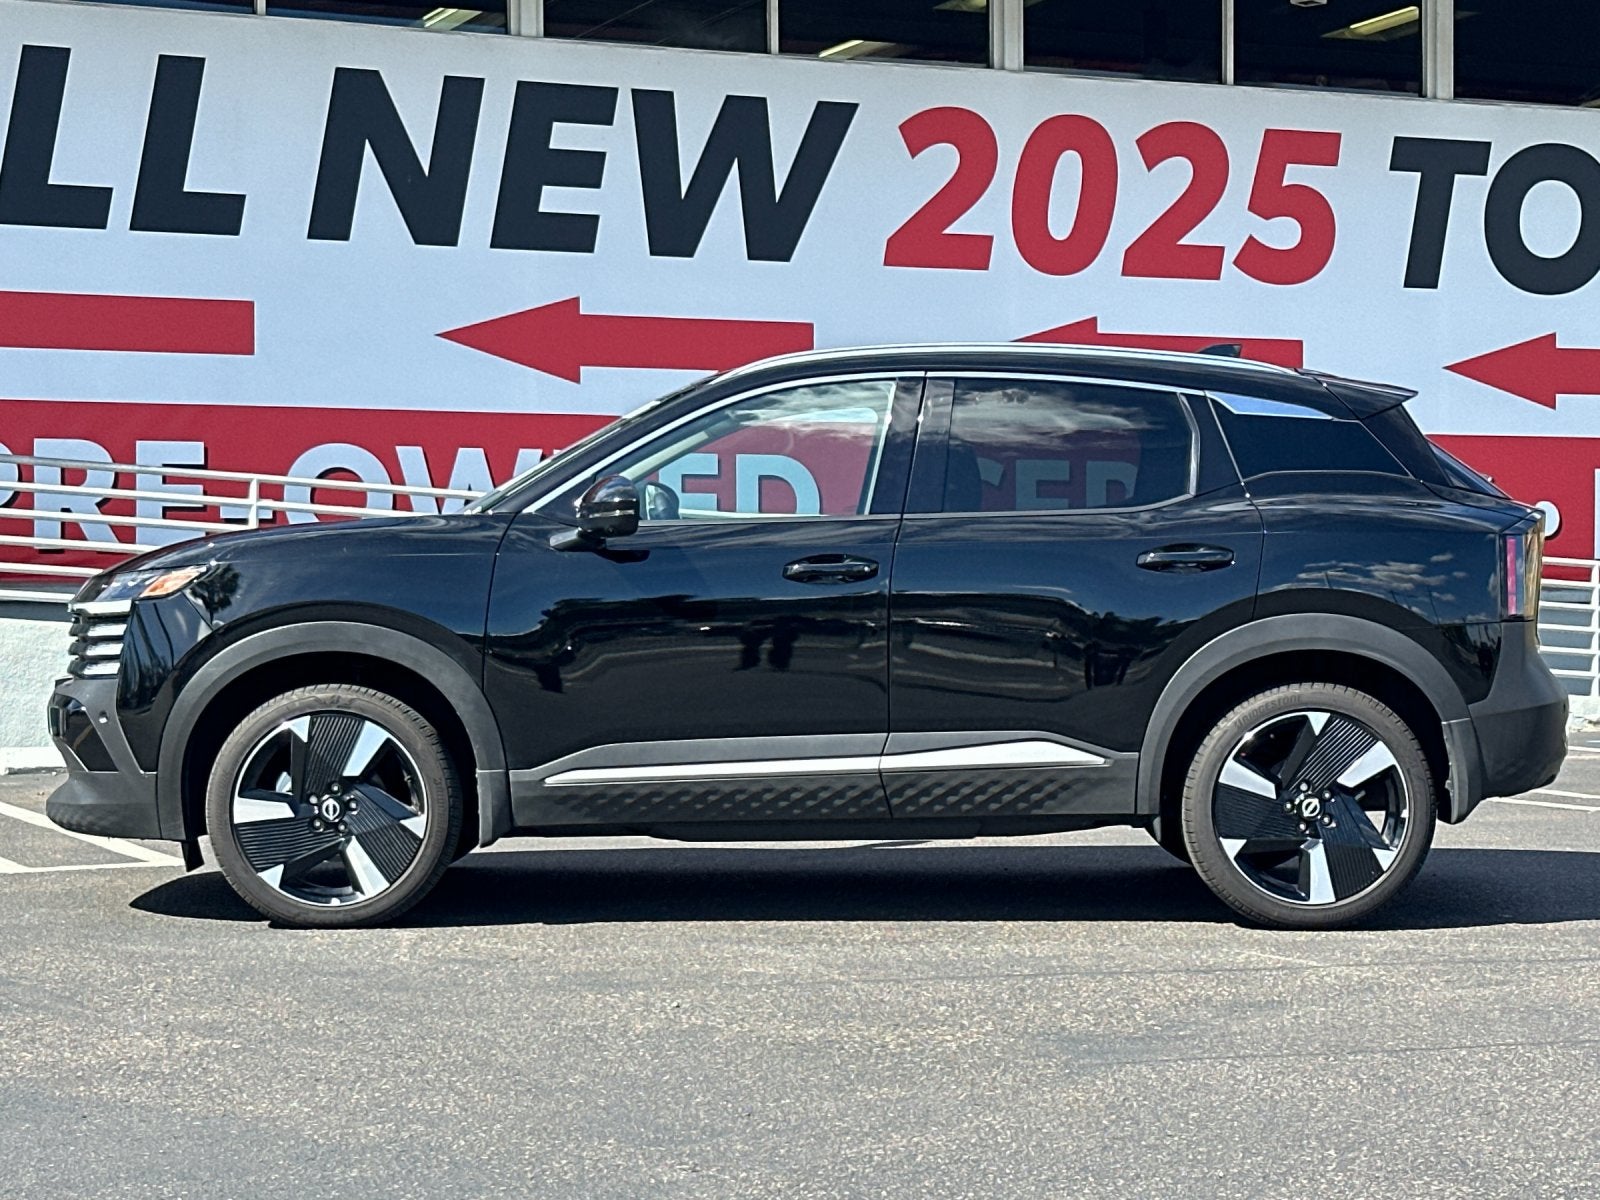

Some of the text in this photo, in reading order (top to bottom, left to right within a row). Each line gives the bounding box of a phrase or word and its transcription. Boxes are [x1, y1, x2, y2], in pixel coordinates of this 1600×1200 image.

[307, 67, 859, 261] NEW
[883, 106, 1342, 286] 2025
[1389, 136, 1600, 295] TO
